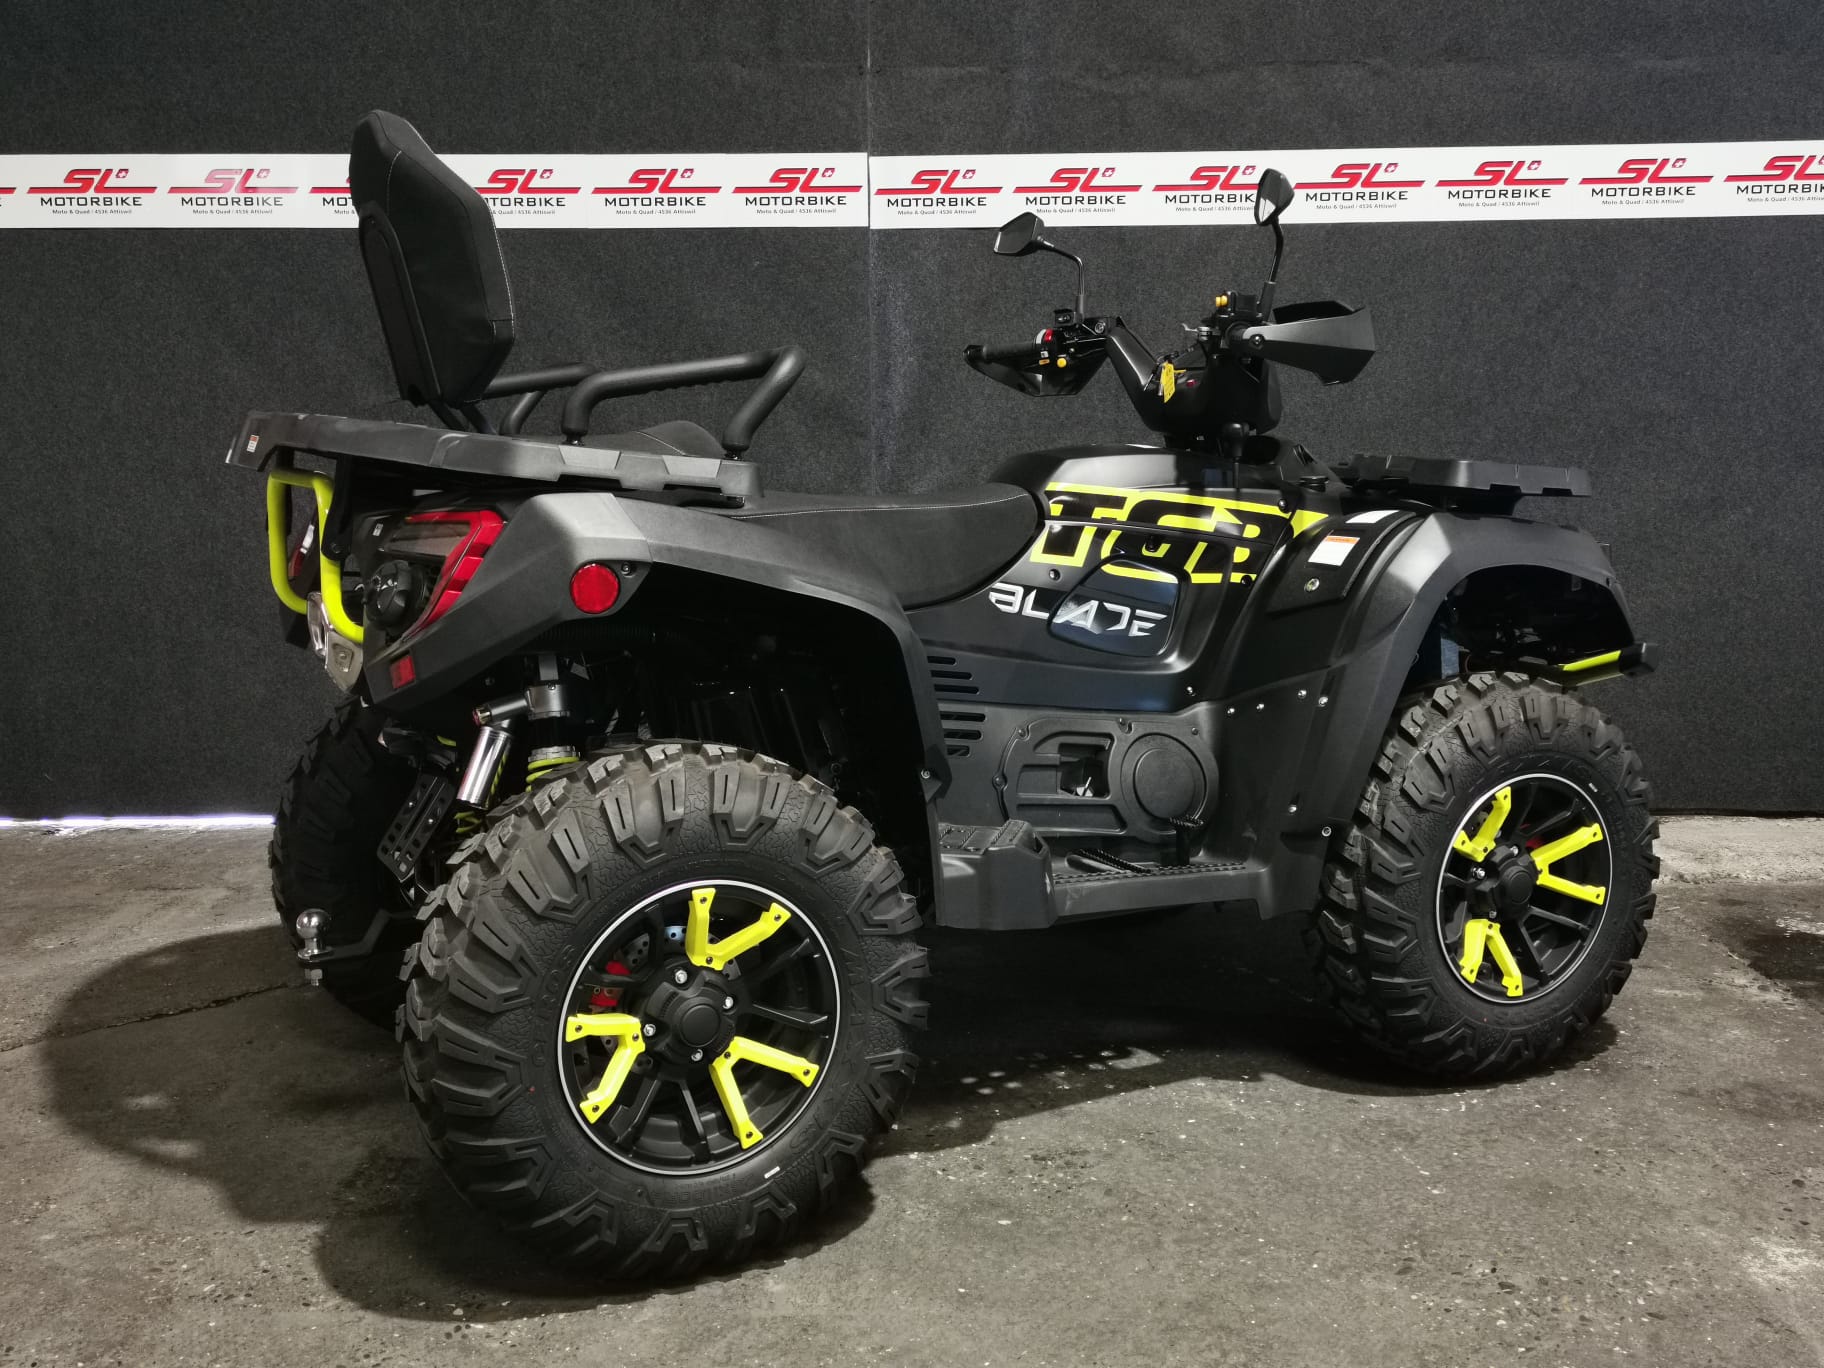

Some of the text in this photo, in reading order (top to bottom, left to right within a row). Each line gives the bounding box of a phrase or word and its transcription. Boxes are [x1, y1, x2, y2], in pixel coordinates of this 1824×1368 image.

[1448, 189, 1552, 199] MOTORBIKE
[1592, 187, 1696, 197] MOTORBIKE
[1737, 184, 1824, 194] MOTORBI
[746, 196, 847, 206] MOTORBIKE
[1026, 196, 1126, 205] MOTORBIKE
[1165, 194, 1255, 204] MOTORBIK
[1306, 191, 1409, 201] MOTORBIKE
[41, 197, 143, 206] MOTORBIKE
[181, 197, 284, 206] MOTORBIKE
[485, 197, 566, 207] TORBIKE
[605, 197, 707, 206] MOTORBIKE
[888, 197, 987, 207] MOTORBIKE
[1034, 484, 1294, 582] TGB
[988, 582, 1168, 637] BLADE
